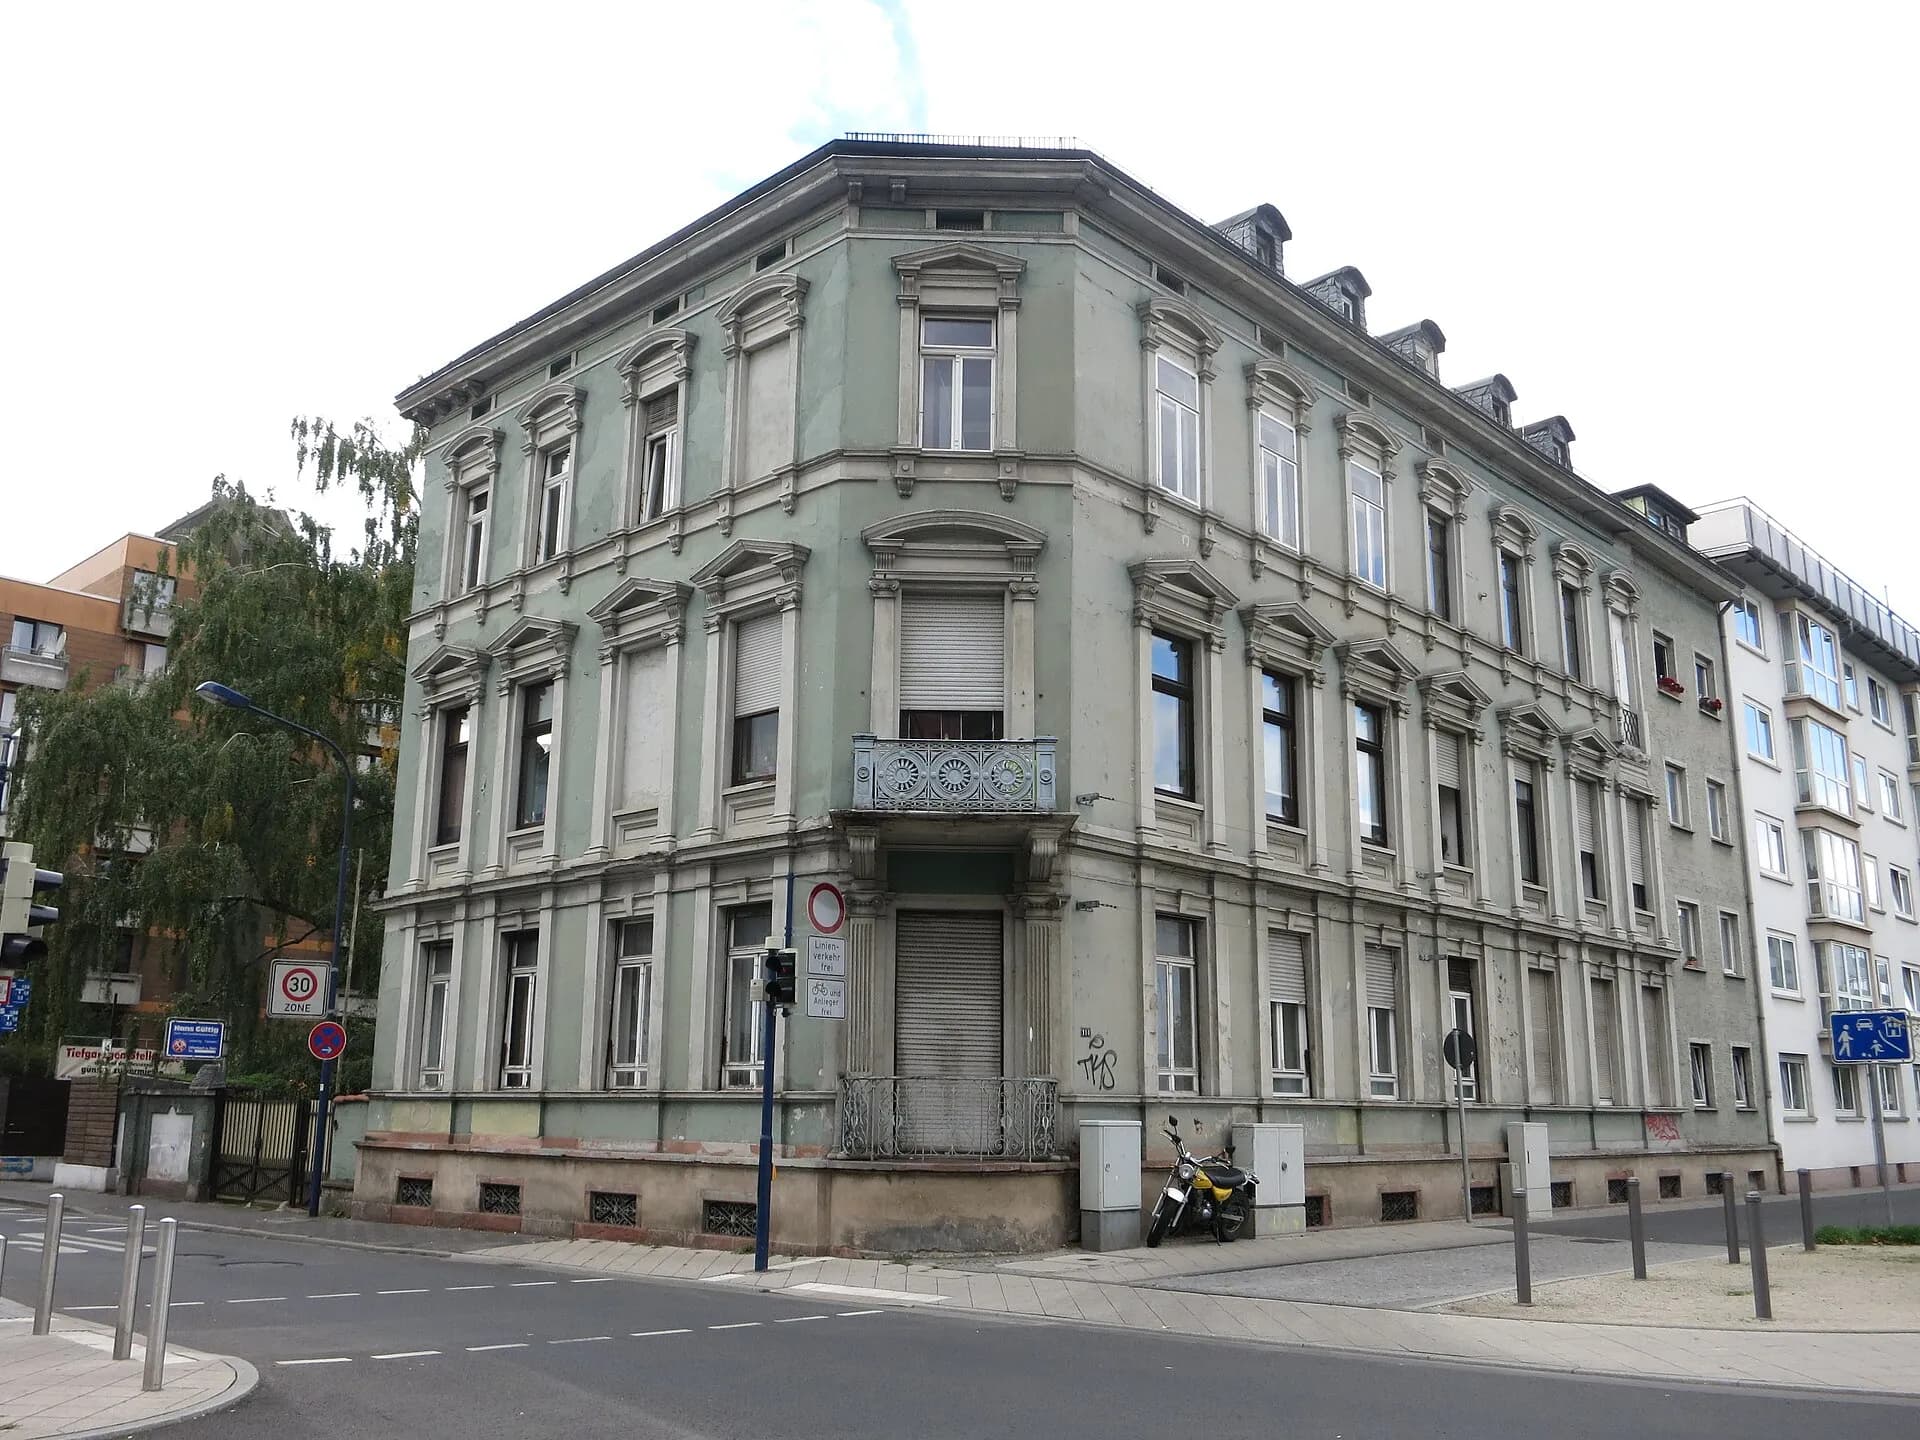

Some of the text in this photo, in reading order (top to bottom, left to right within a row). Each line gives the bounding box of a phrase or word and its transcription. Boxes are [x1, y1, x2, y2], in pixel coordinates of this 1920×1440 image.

[814, 941, 839, 951] Linien-
[813, 952, 841, 961] verkehr
[821, 962, 834, 972] frei
[289, 977, 310, 992] 30
[813, 997, 840, 1007] Anlieger
[284, 1003, 311, 1012] ZONE
[821, 1007, 832, 1016] frei
